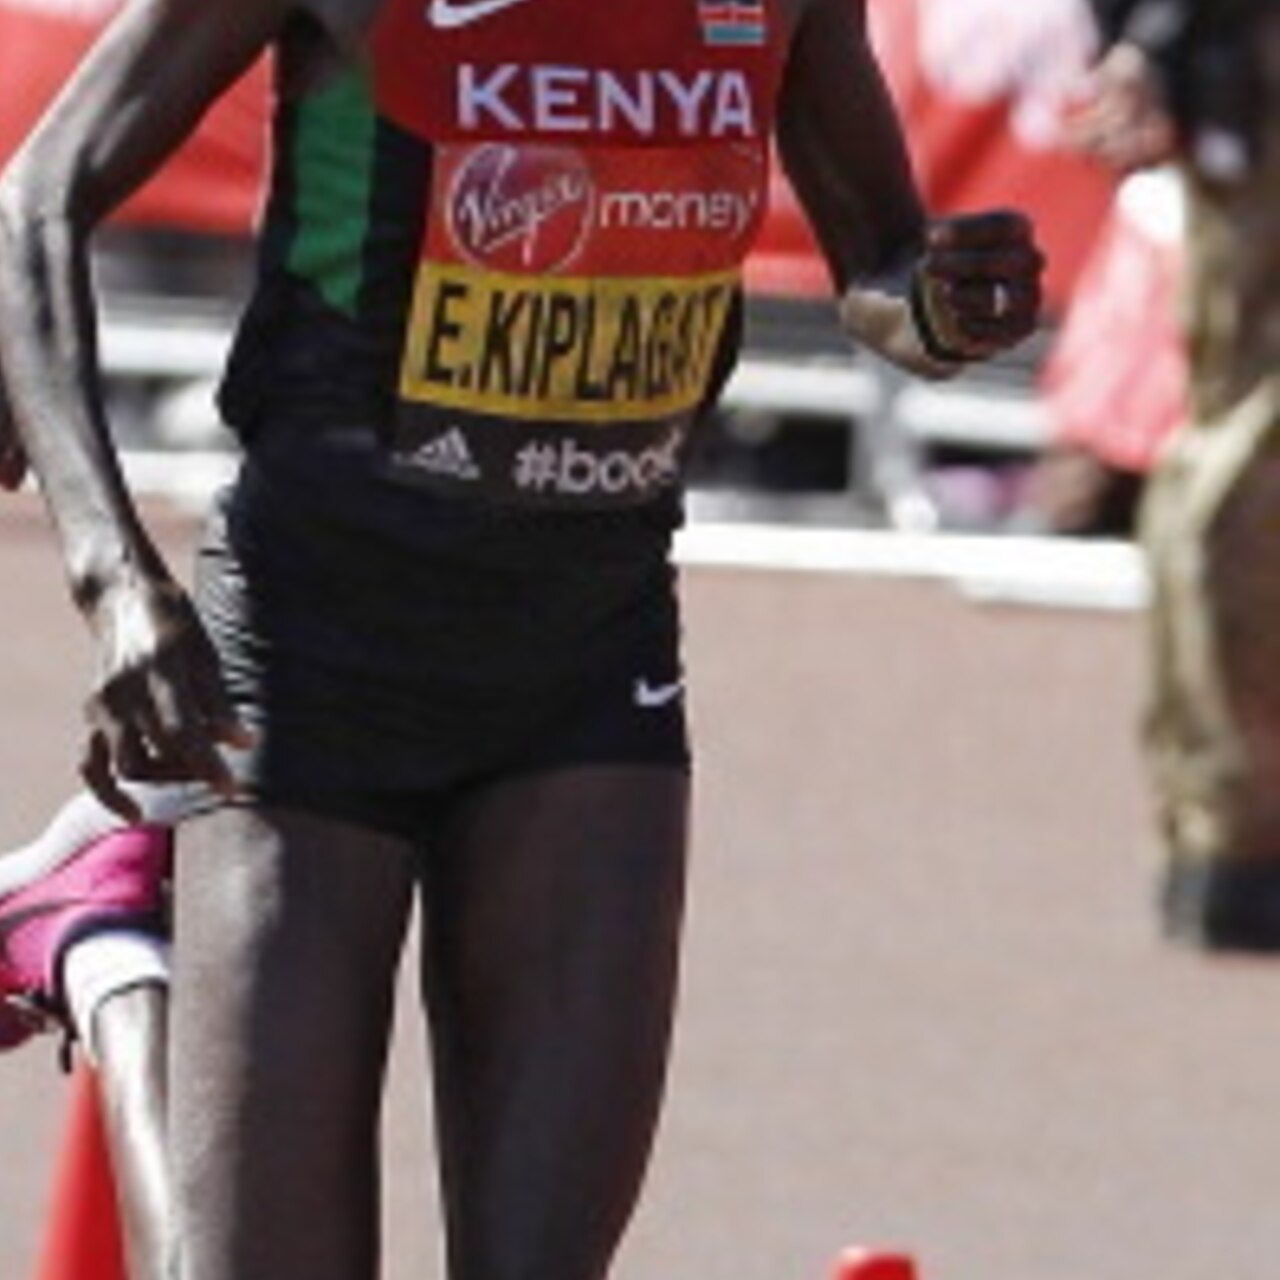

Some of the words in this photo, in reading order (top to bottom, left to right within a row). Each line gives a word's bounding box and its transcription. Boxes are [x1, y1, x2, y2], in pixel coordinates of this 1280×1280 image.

[456, 63, 756, 138] KENYA
[456, 144, 590, 266] Virgin
[597, 190, 758, 240] money
